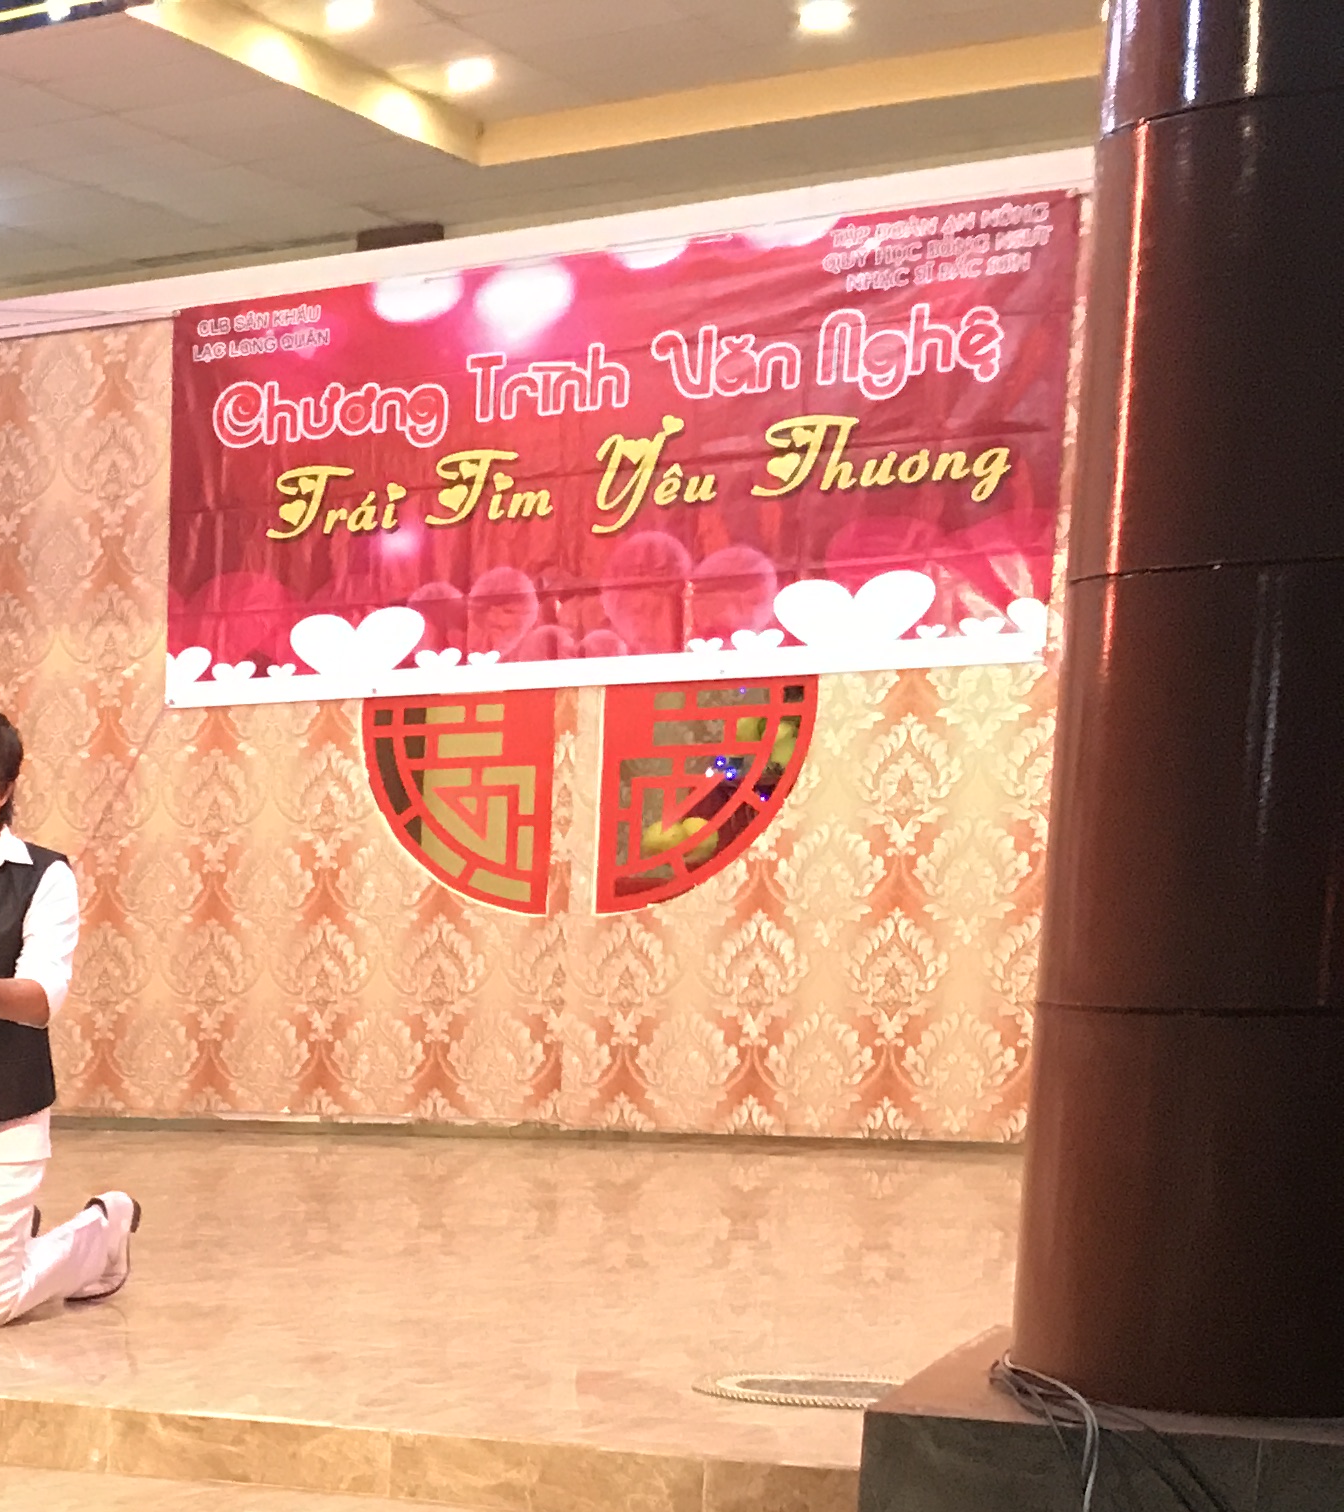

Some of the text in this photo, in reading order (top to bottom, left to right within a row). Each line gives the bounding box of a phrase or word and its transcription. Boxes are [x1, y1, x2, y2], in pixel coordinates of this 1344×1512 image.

[212, 381, 450, 449] Chương
[650, 323, 802, 400] Văn
[816, 302, 1005, 401] Nghệ
[228, 335, 278, 358] LONG
[265, 463, 408, 541] Trái
[424, 447, 554, 527] Tim
[591, 413, 718, 535] Yêu
